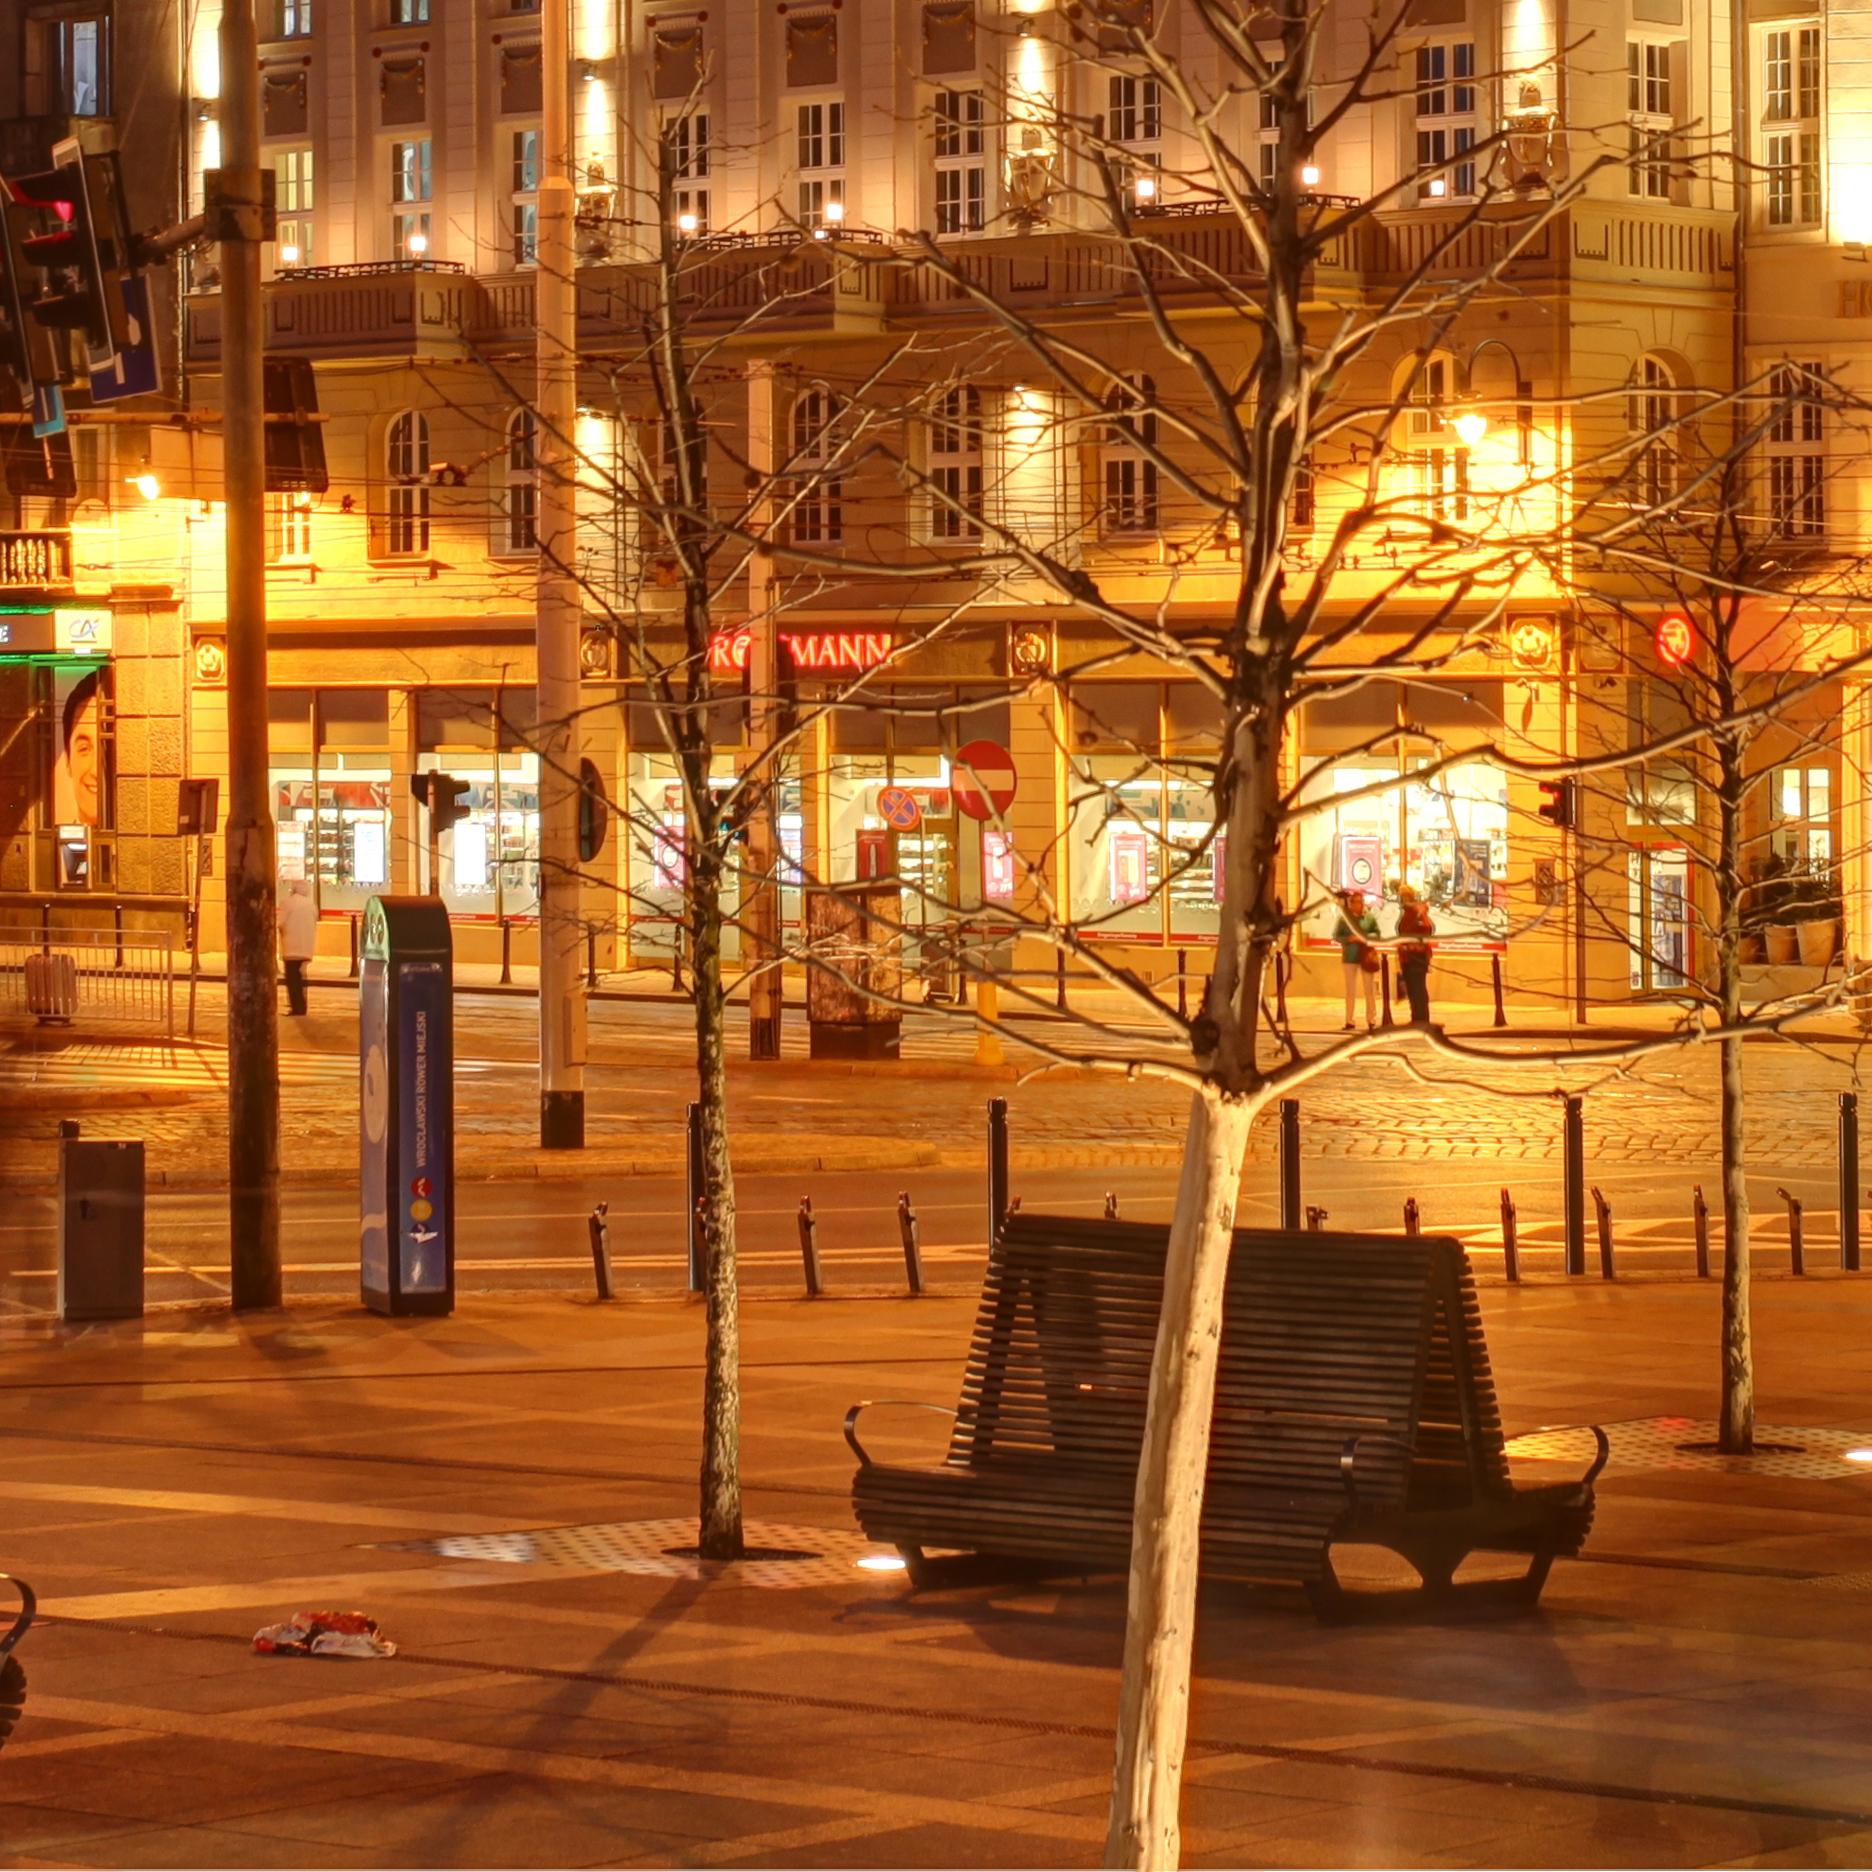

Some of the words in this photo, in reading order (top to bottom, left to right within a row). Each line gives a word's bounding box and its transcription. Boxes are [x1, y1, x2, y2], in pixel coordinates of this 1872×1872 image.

[712, 634, 892, 667] ROMANN
[415, 1010, 427, 1054] MIEJSKI
[415, 1055, 427, 1094] ROWER
[415, 1095, 427, 1169] WROCŁAWSKI
